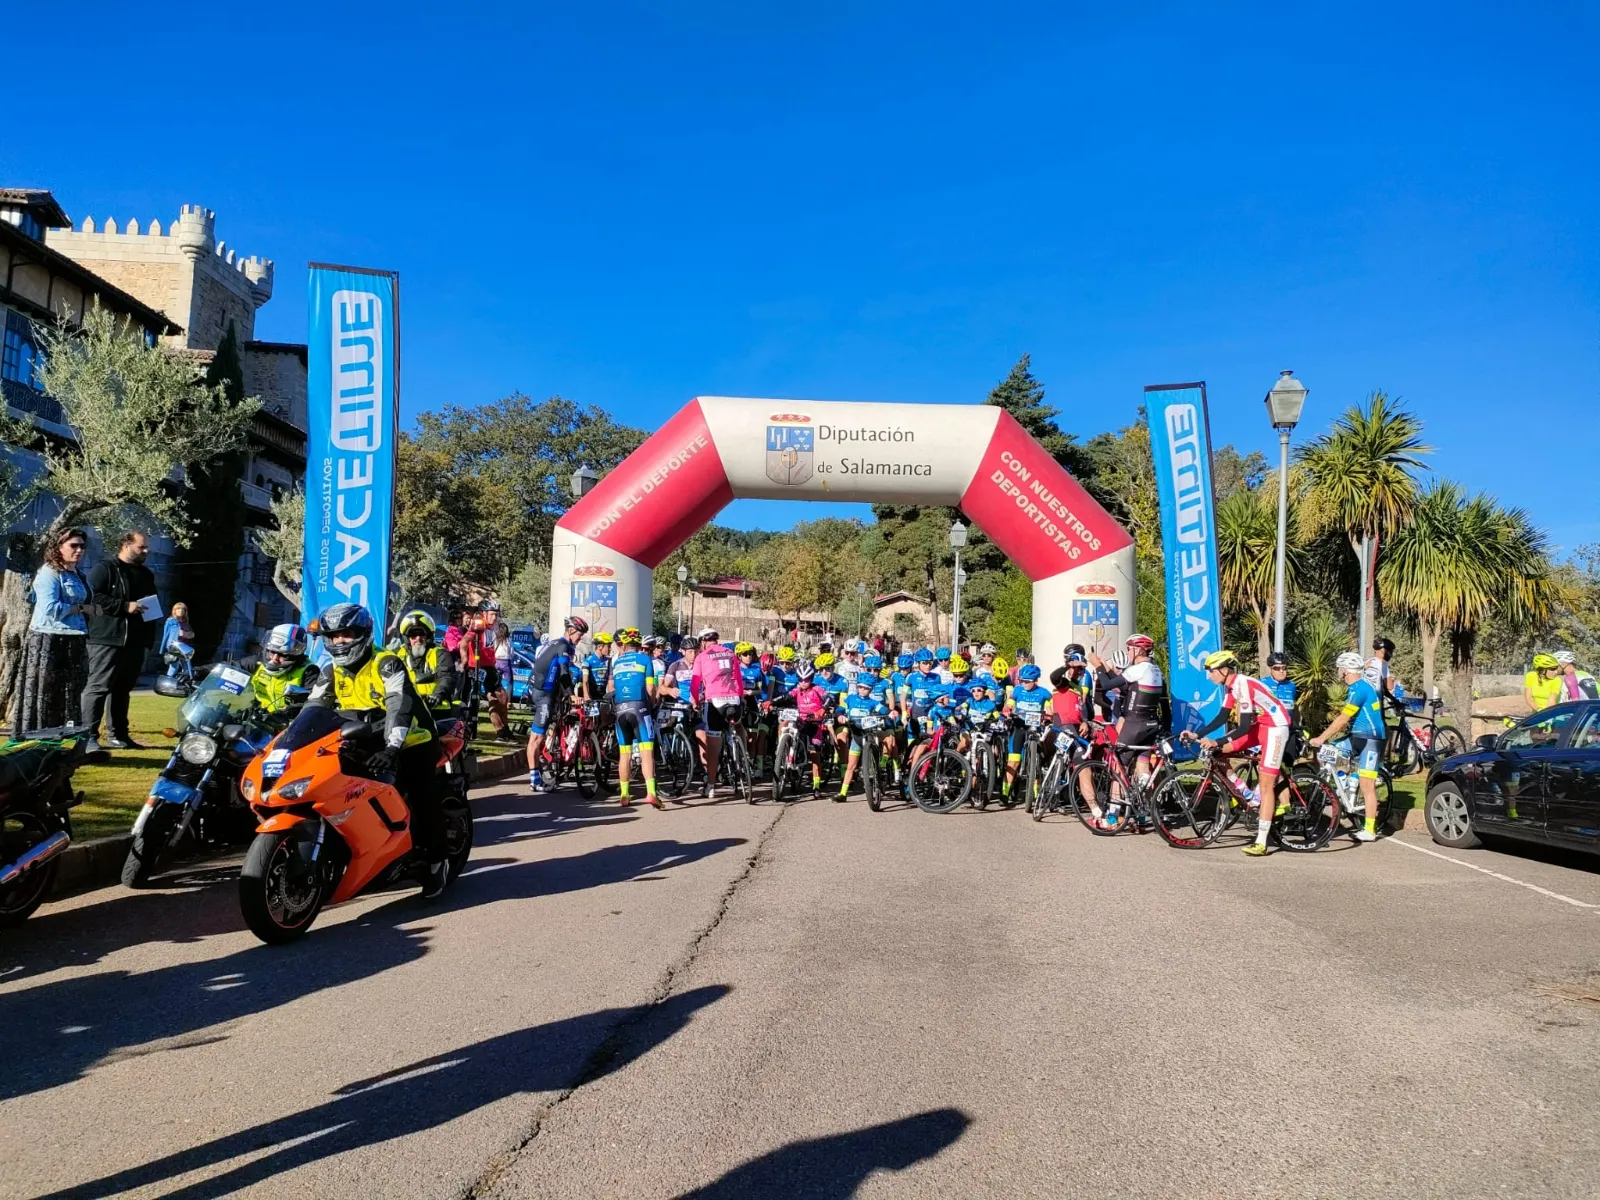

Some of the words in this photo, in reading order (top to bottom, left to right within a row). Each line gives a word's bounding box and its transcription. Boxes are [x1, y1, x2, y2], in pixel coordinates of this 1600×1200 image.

[817, 461, 833, 473] de
[840, 458, 932, 476] Salamanca
[819, 425, 914, 444] Diputación
[587, 508, 622, 538] CON
[622, 493, 643, 512] EL
[642, 433, 709, 495] DEPORTE
[991, 469, 1081, 560] DEPORTISTAS
[1000, 451, 1032, 482] CON
[1029, 479, 1102, 551] NUESTROS
